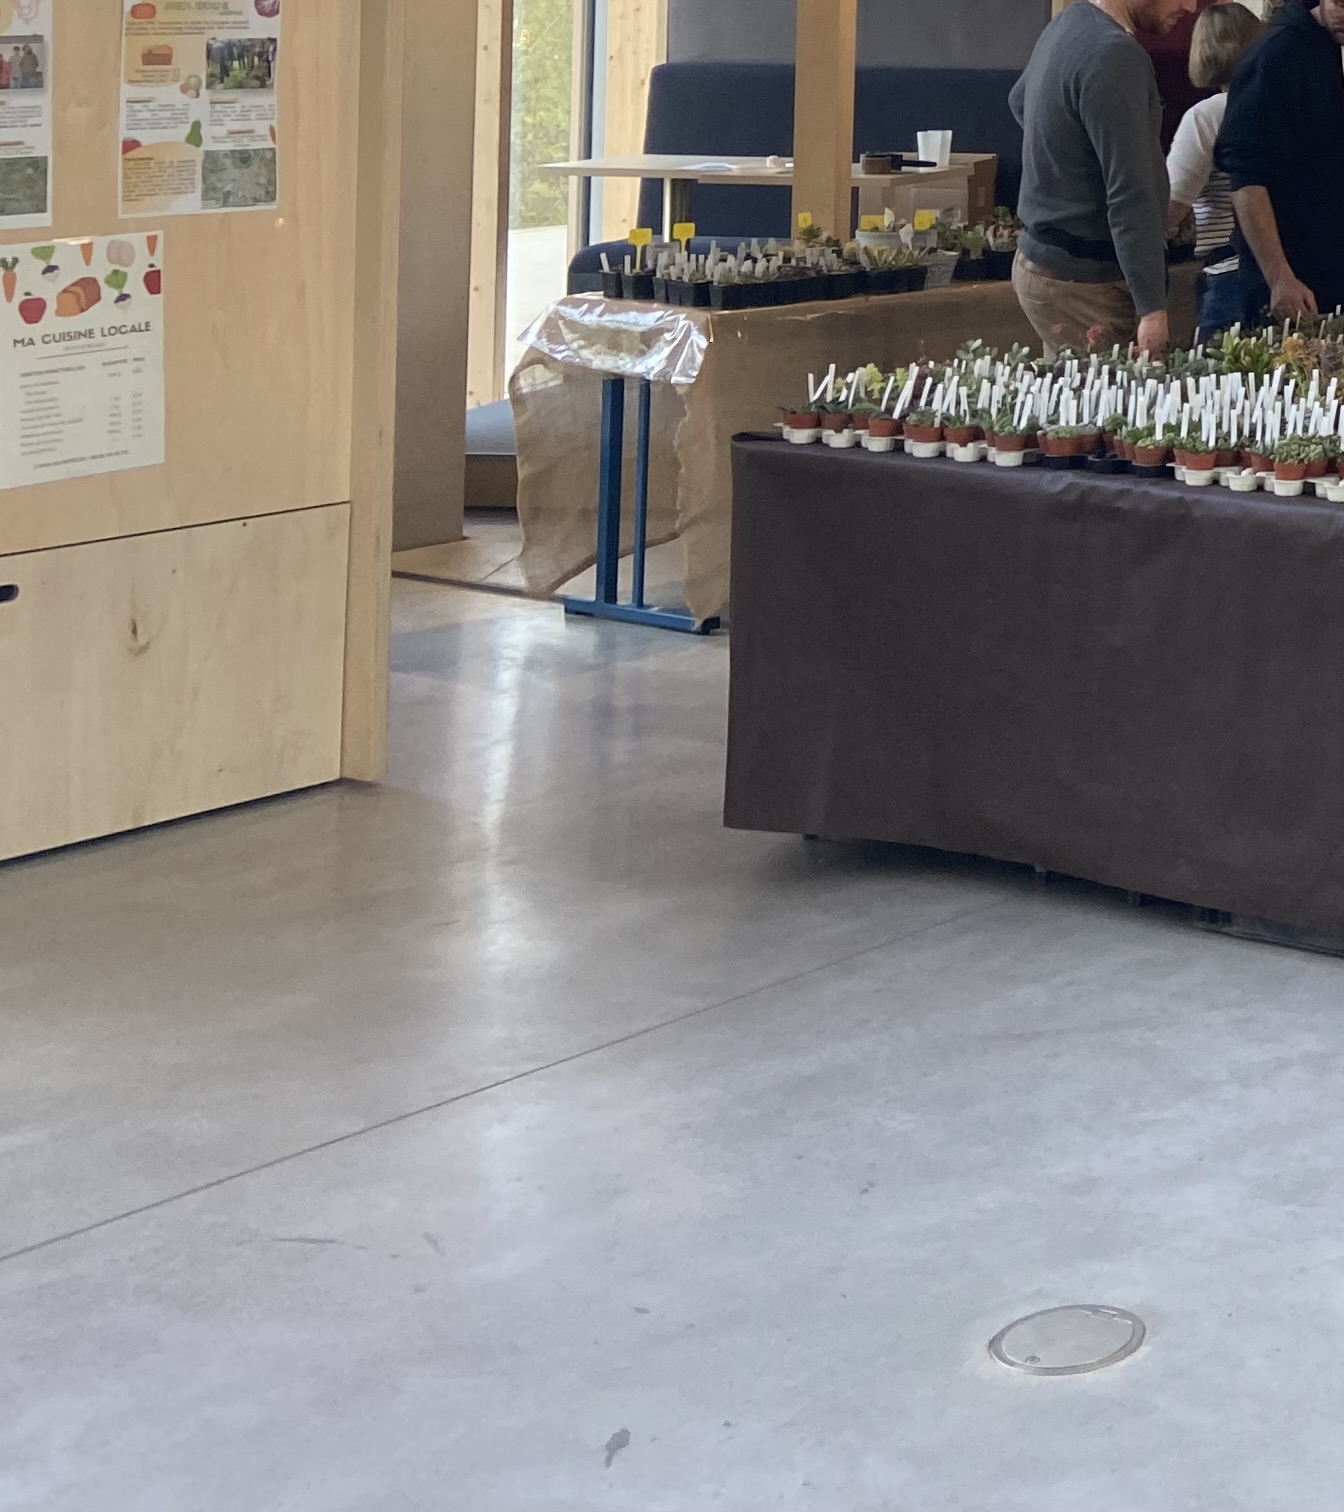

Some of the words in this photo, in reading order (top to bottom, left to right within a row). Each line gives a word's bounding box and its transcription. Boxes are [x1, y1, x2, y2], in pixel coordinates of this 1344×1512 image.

[12, 337, 36, 349] MA
[41, 328, 96, 345] CUISINE
[100, 321, 152, 337] LOCALE
